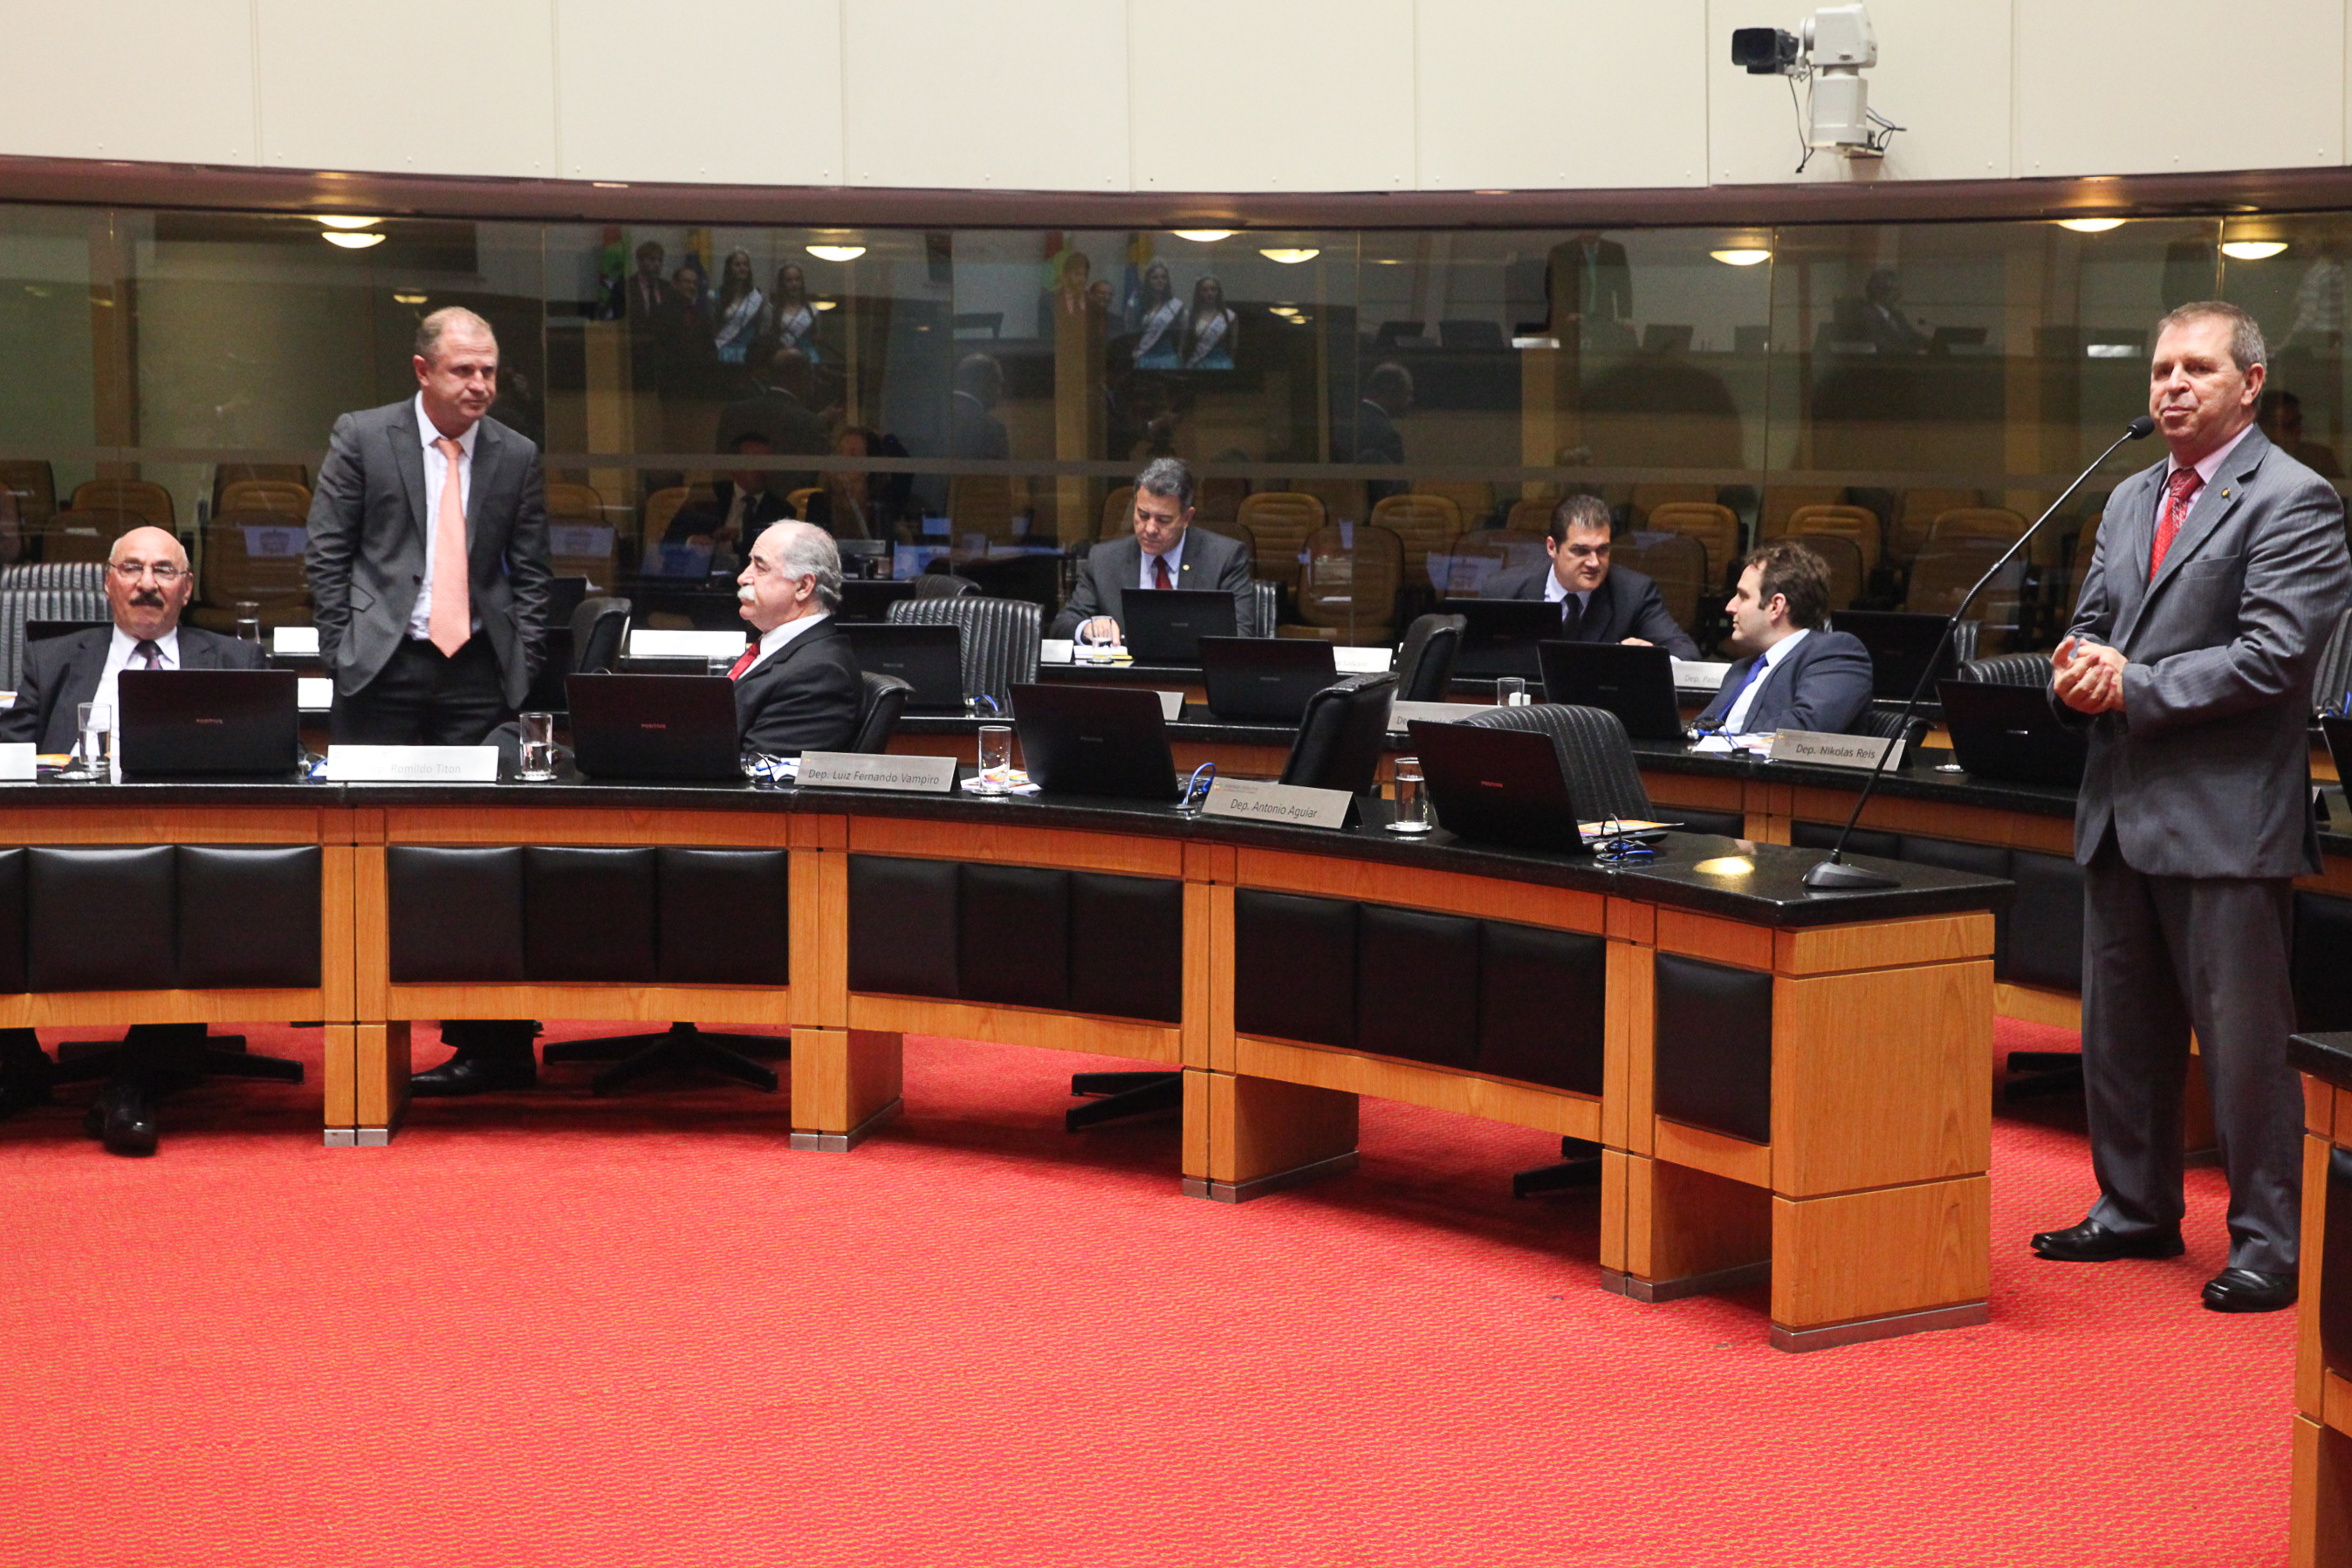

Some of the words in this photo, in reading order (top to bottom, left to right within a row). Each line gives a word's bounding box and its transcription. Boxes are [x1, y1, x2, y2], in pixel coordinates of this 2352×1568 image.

[1795, 743, 1816, 756] Dep.
[1820, 745, 1854, 757] Nikolas
[1855, 748, 1876, 759] Reis
[391, 763, 433, 774] Romildo
[436, 763, 462, 774] Titon
[808, 769, 829, 781] Dep.
[833, 770, 852, 781] Luiz
[854, 770, 898, 783] Fernando
[901, 772, 940, 786] Vampiro
[1230, 798, 1250, 812] Dep.
[1251, 801, 1287, 815] Antonio
[1287, 805, 1319, 819] Aguiar
